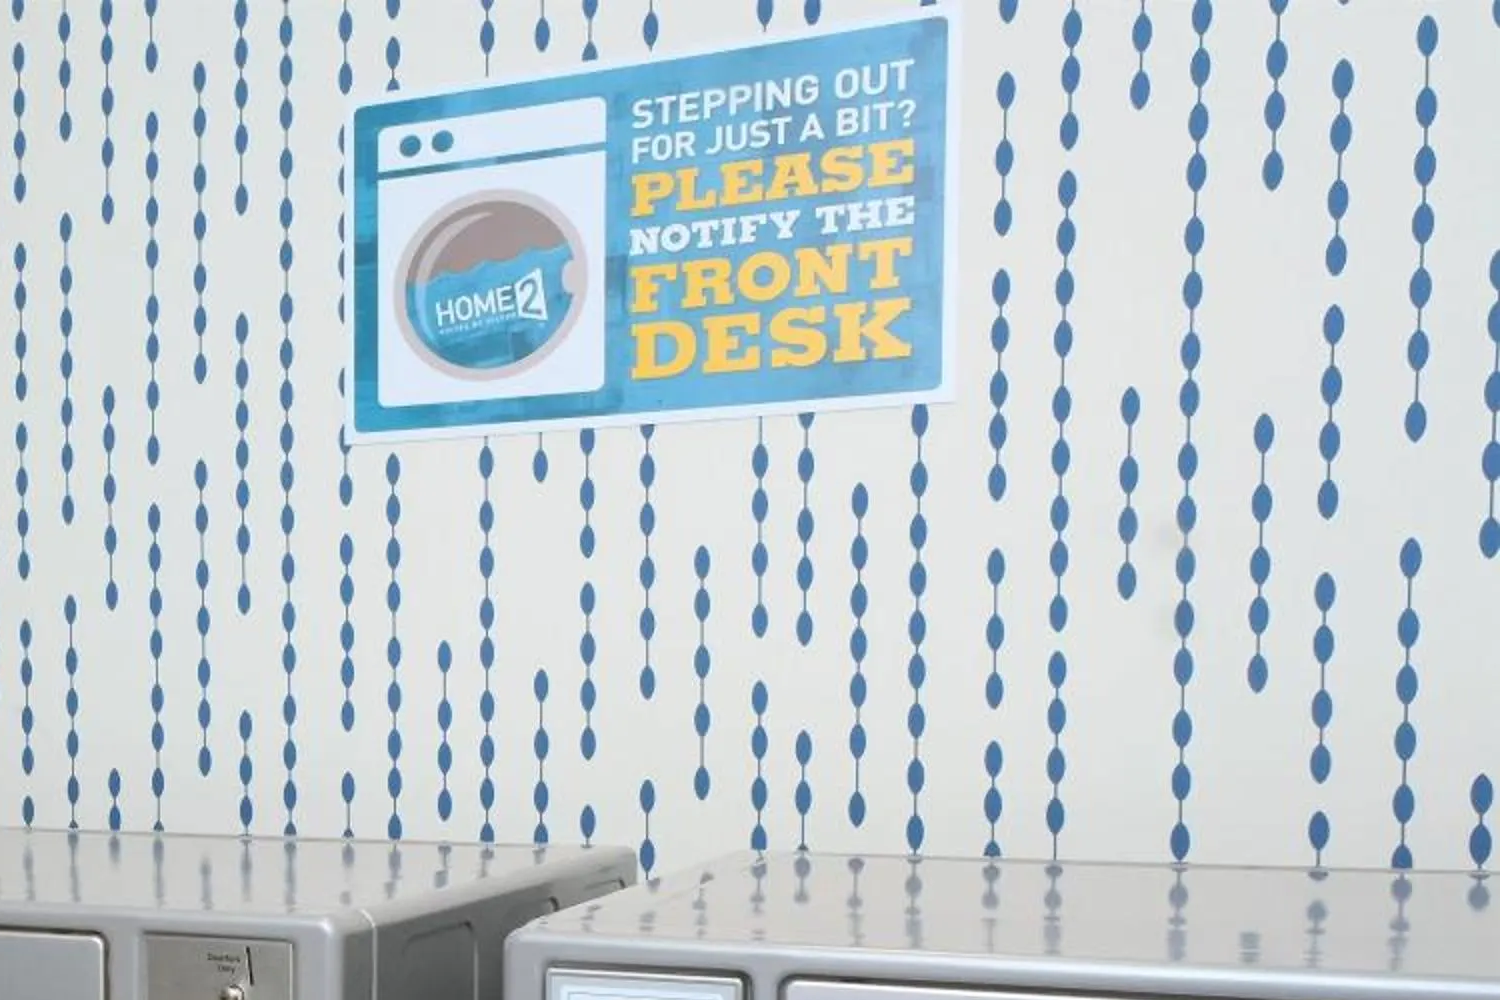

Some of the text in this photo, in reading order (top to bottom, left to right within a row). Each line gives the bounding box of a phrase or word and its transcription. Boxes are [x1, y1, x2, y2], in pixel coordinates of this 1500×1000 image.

[632, 59, 915, 129] STEPPING OUT
[632, 100, 916, 164] FOR JUST A BIT?
[630, 138, 915, 217] PLEASE
[629, 196, 915, 256] NOTIFY THE
[629, 236, 913, 313] FRONT
[630, 297, 912, 380] DESK
